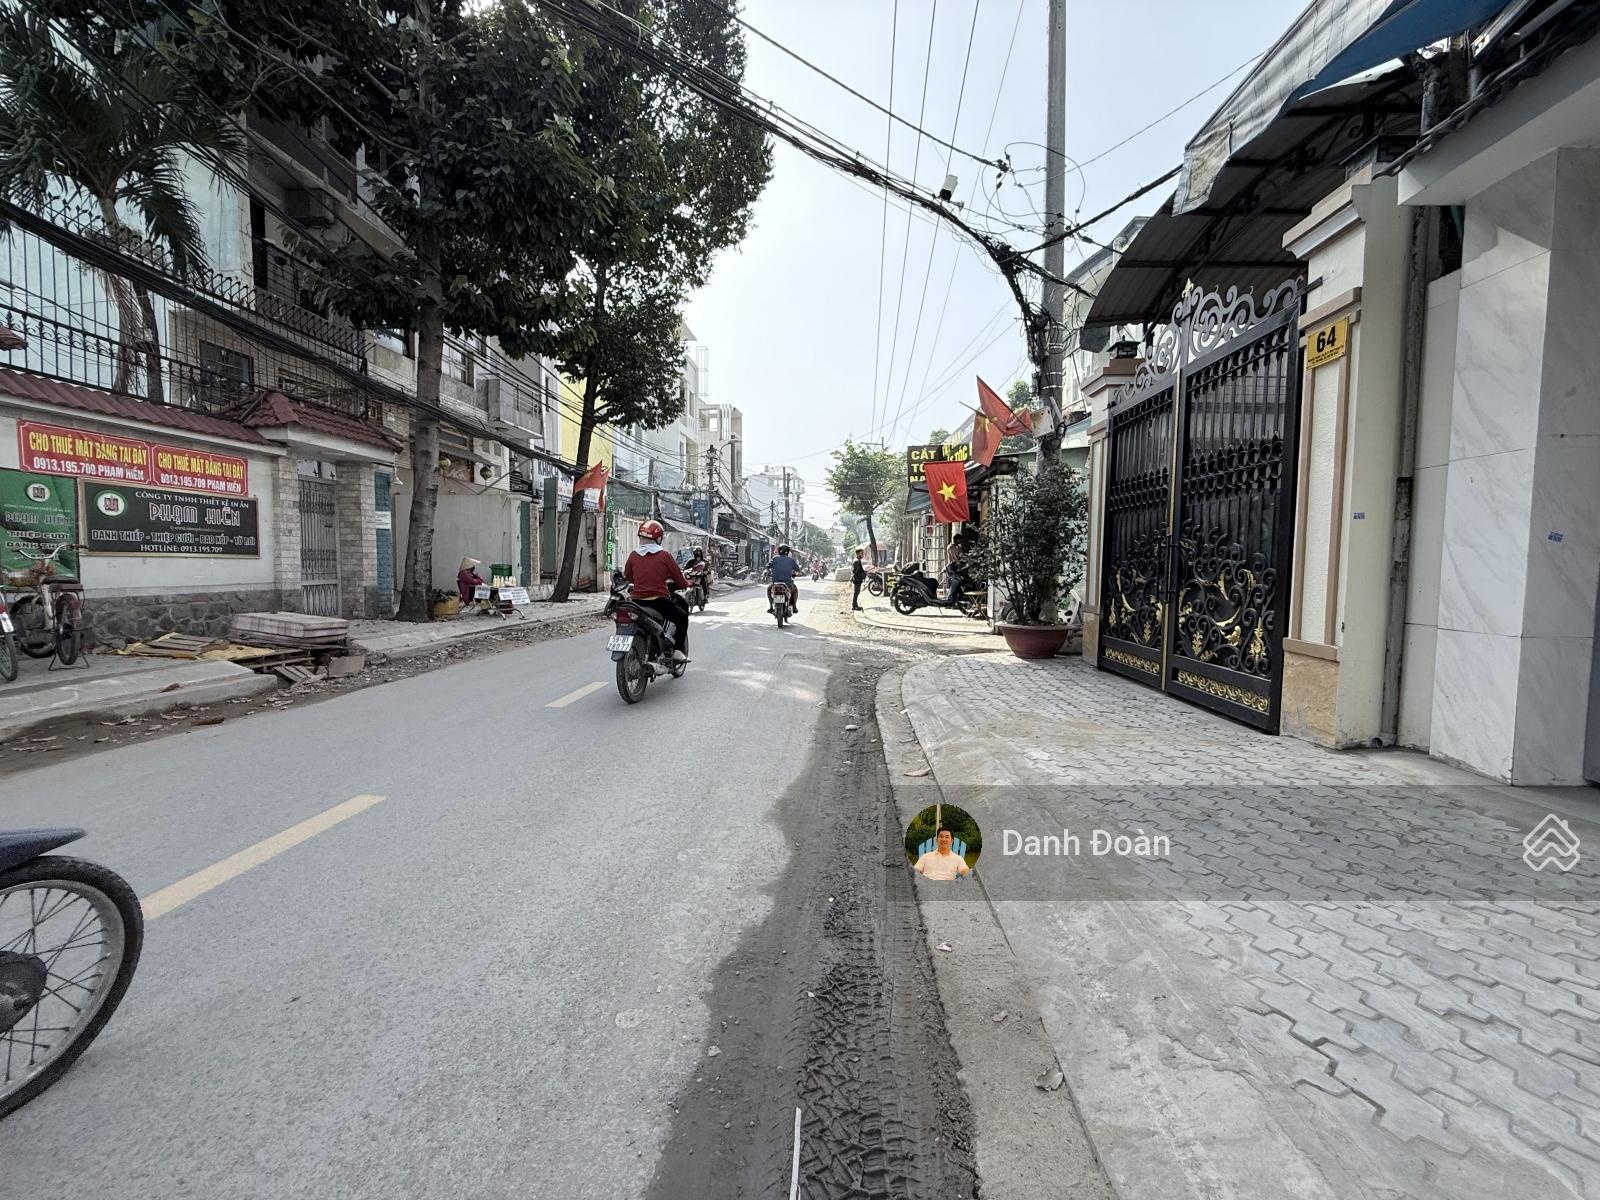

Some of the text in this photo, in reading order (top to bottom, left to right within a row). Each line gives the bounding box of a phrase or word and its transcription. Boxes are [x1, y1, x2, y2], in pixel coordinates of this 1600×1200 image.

[1317, 326, 1336, 353] 64
[29, 432, 147, 466] CHO THUÊ MẶT BẰNG TẠI ĐÂY
[911, 447, 936, 460] CẮT
[33, 457, 97, 475] 0913.195.709
[98, 466, 124, 480] PHẠM
[158, 452, 243, 480] CHO THUÊ MẶT BẰNG TẠI ĐÂY
[160, 473, 206, 489] 0913.195.709
[207, 479, 226, 493] PHẠM
[135, 491, 161, 500] CÔNG
[174, 495, 197, 503] TNHH
[149, 502, 198, 525] PHẠM
[91, 529, 118, 541] DANH
[180, 545, 223, 553] 0913.195.709
